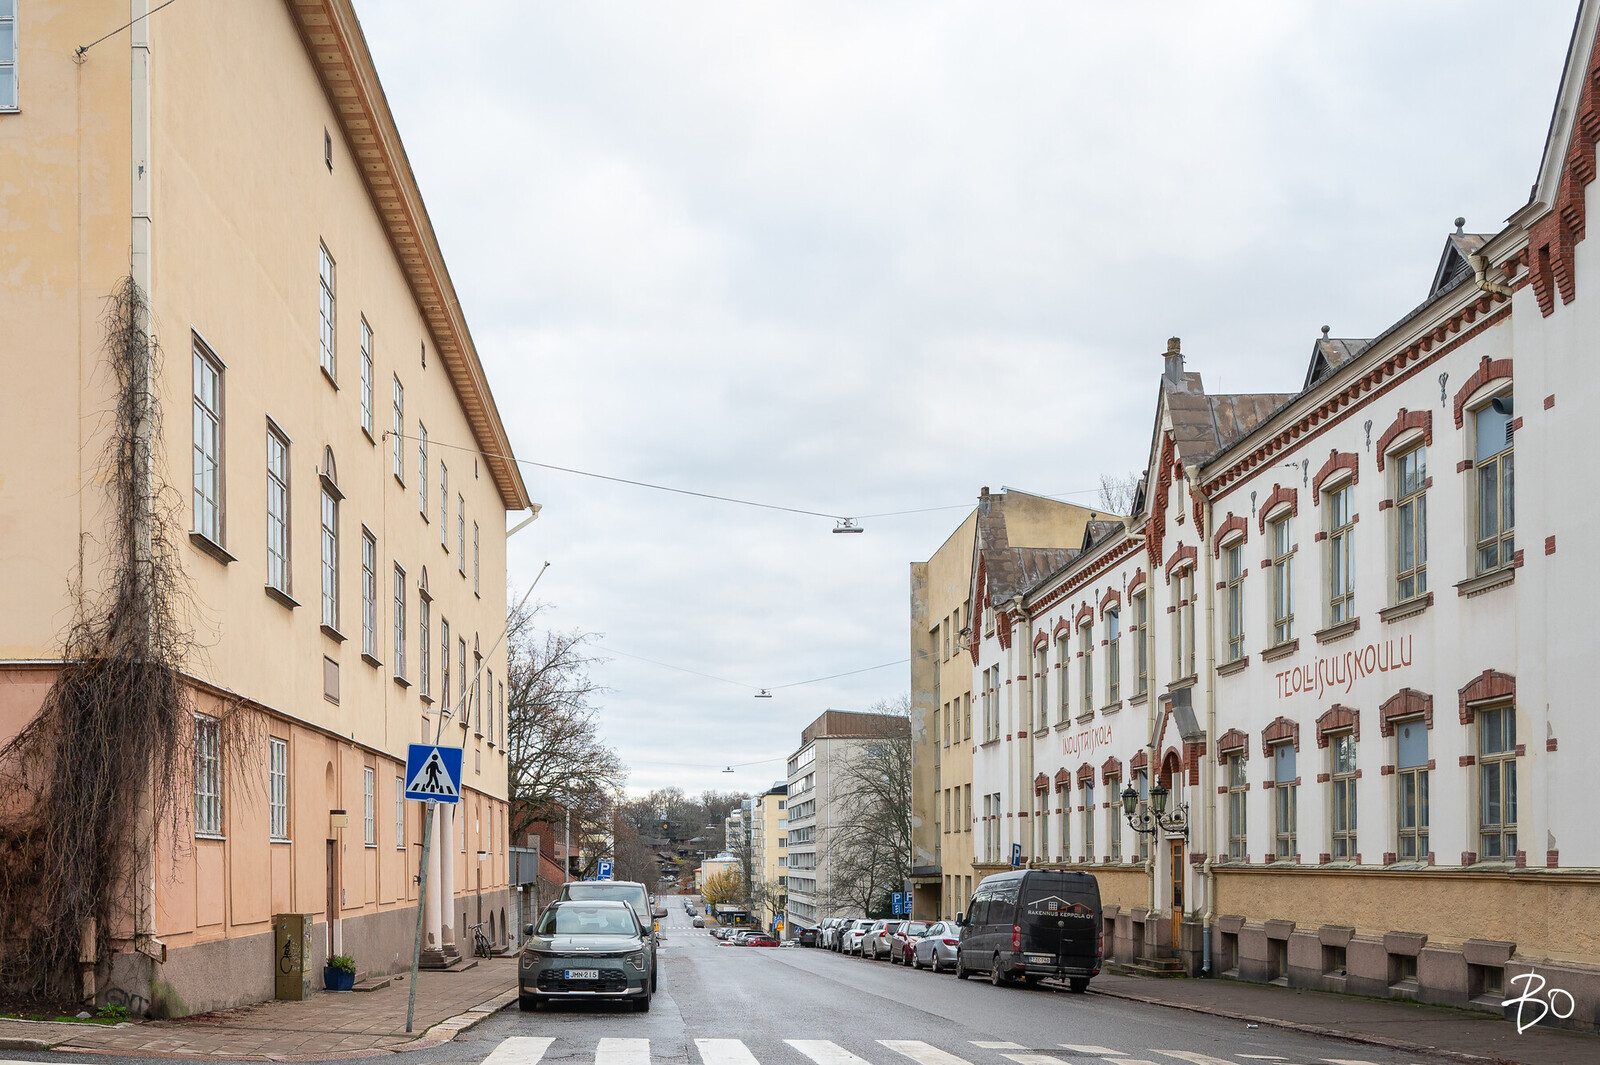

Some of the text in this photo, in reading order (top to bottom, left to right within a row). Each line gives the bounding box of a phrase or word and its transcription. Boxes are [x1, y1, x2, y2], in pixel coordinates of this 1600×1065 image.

[1275, 634, 1412, 700] TEOLLISUUSKOULU
[1062, 725, 1113, 759] INDUSTRISKOLA
[1013, 845, 1021, 865] P
[600, 862, 610, 875] P
[894, 893, 901, 903] P
[1027, 909, 1058, 917] RAKENNUS
[1060, 911, 1086, 919] KEPPOLA
